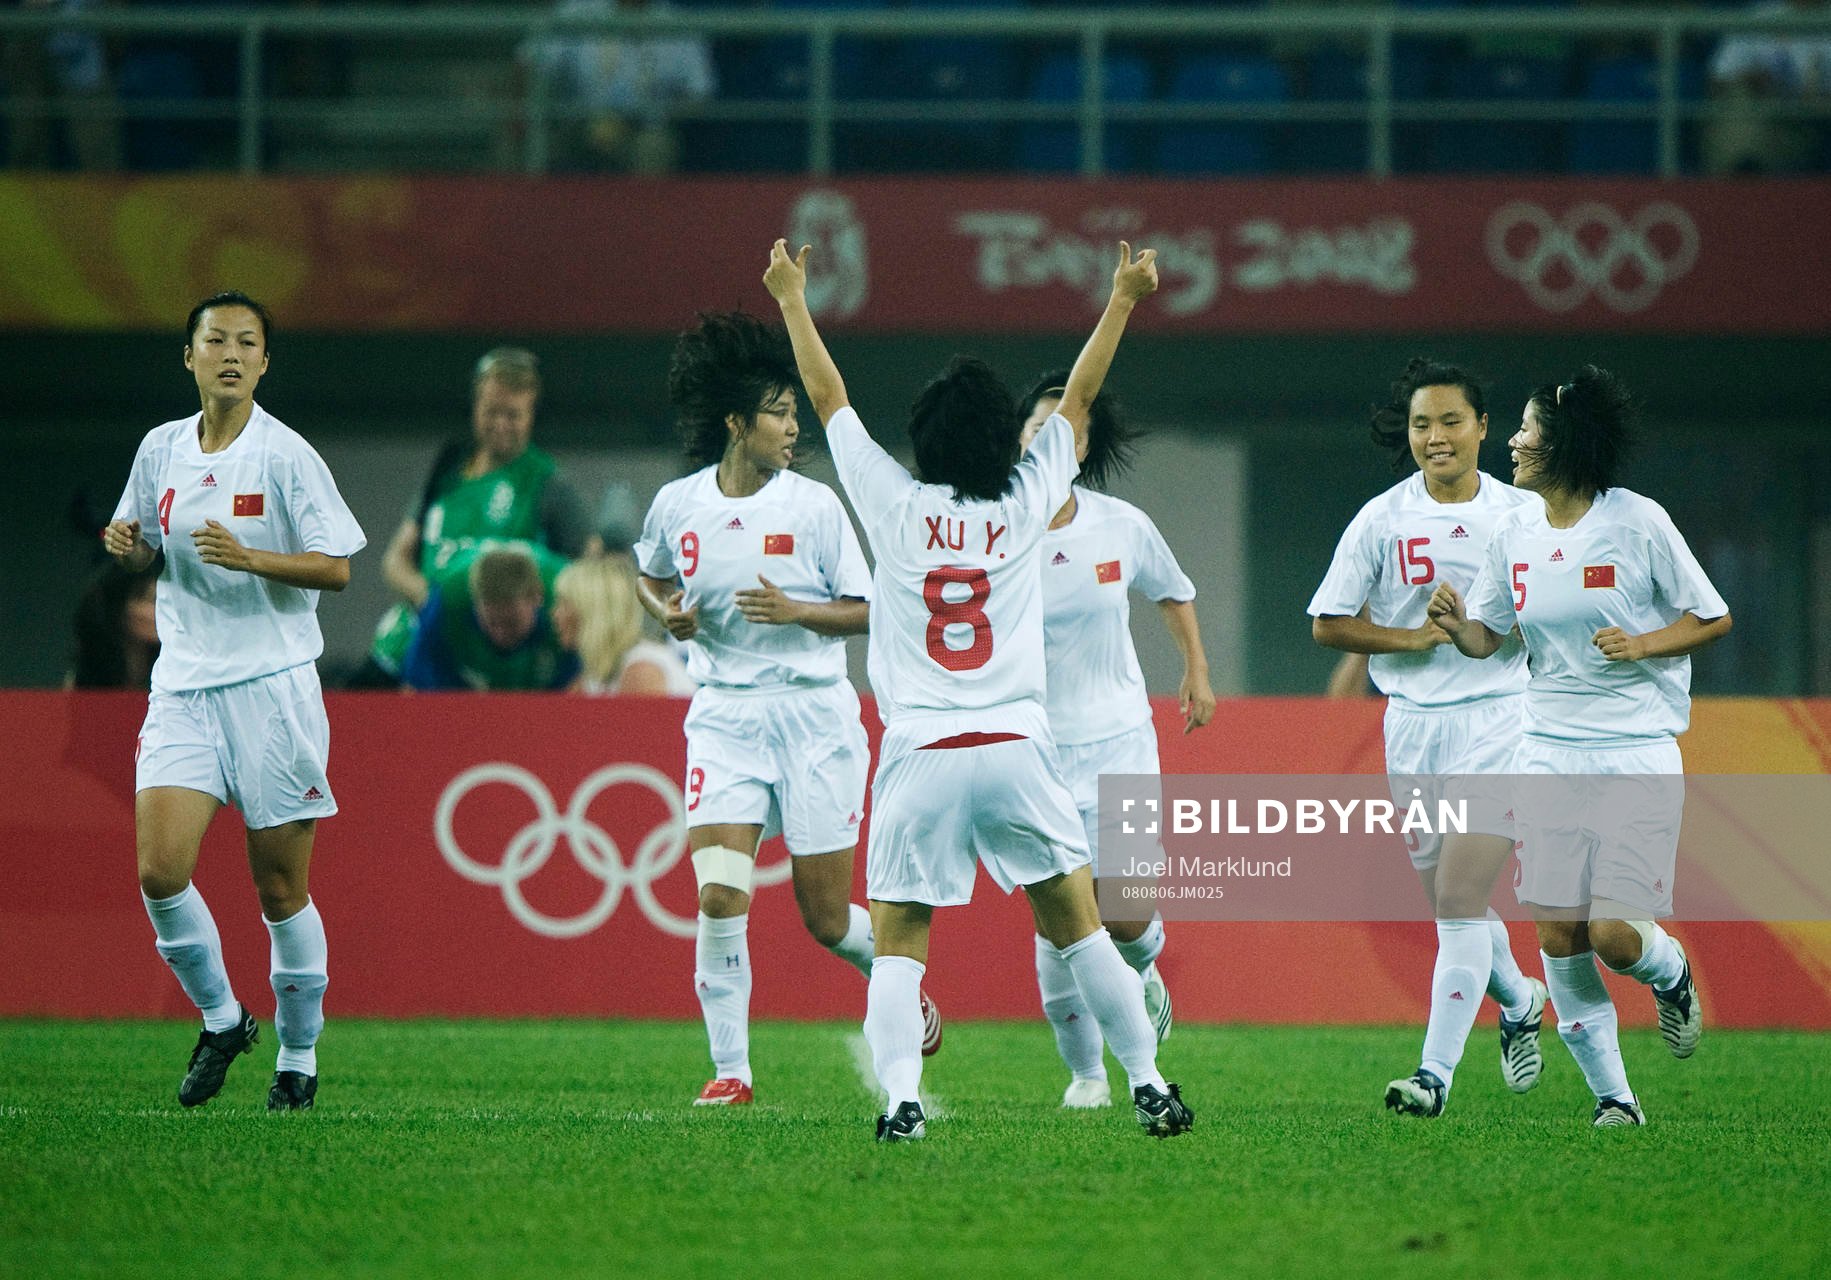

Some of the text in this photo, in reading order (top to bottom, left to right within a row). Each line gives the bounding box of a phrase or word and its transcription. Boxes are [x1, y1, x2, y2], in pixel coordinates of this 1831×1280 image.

[158, 488, 175, 536] 4
[681, 531, 699, 577] 9
[925, 515, 1006, 559] XU Y.
[1398, 537, 1435, 585] 15
[1513, 563, 1529, 611] 5
[923, 564, 993, 671] 8
